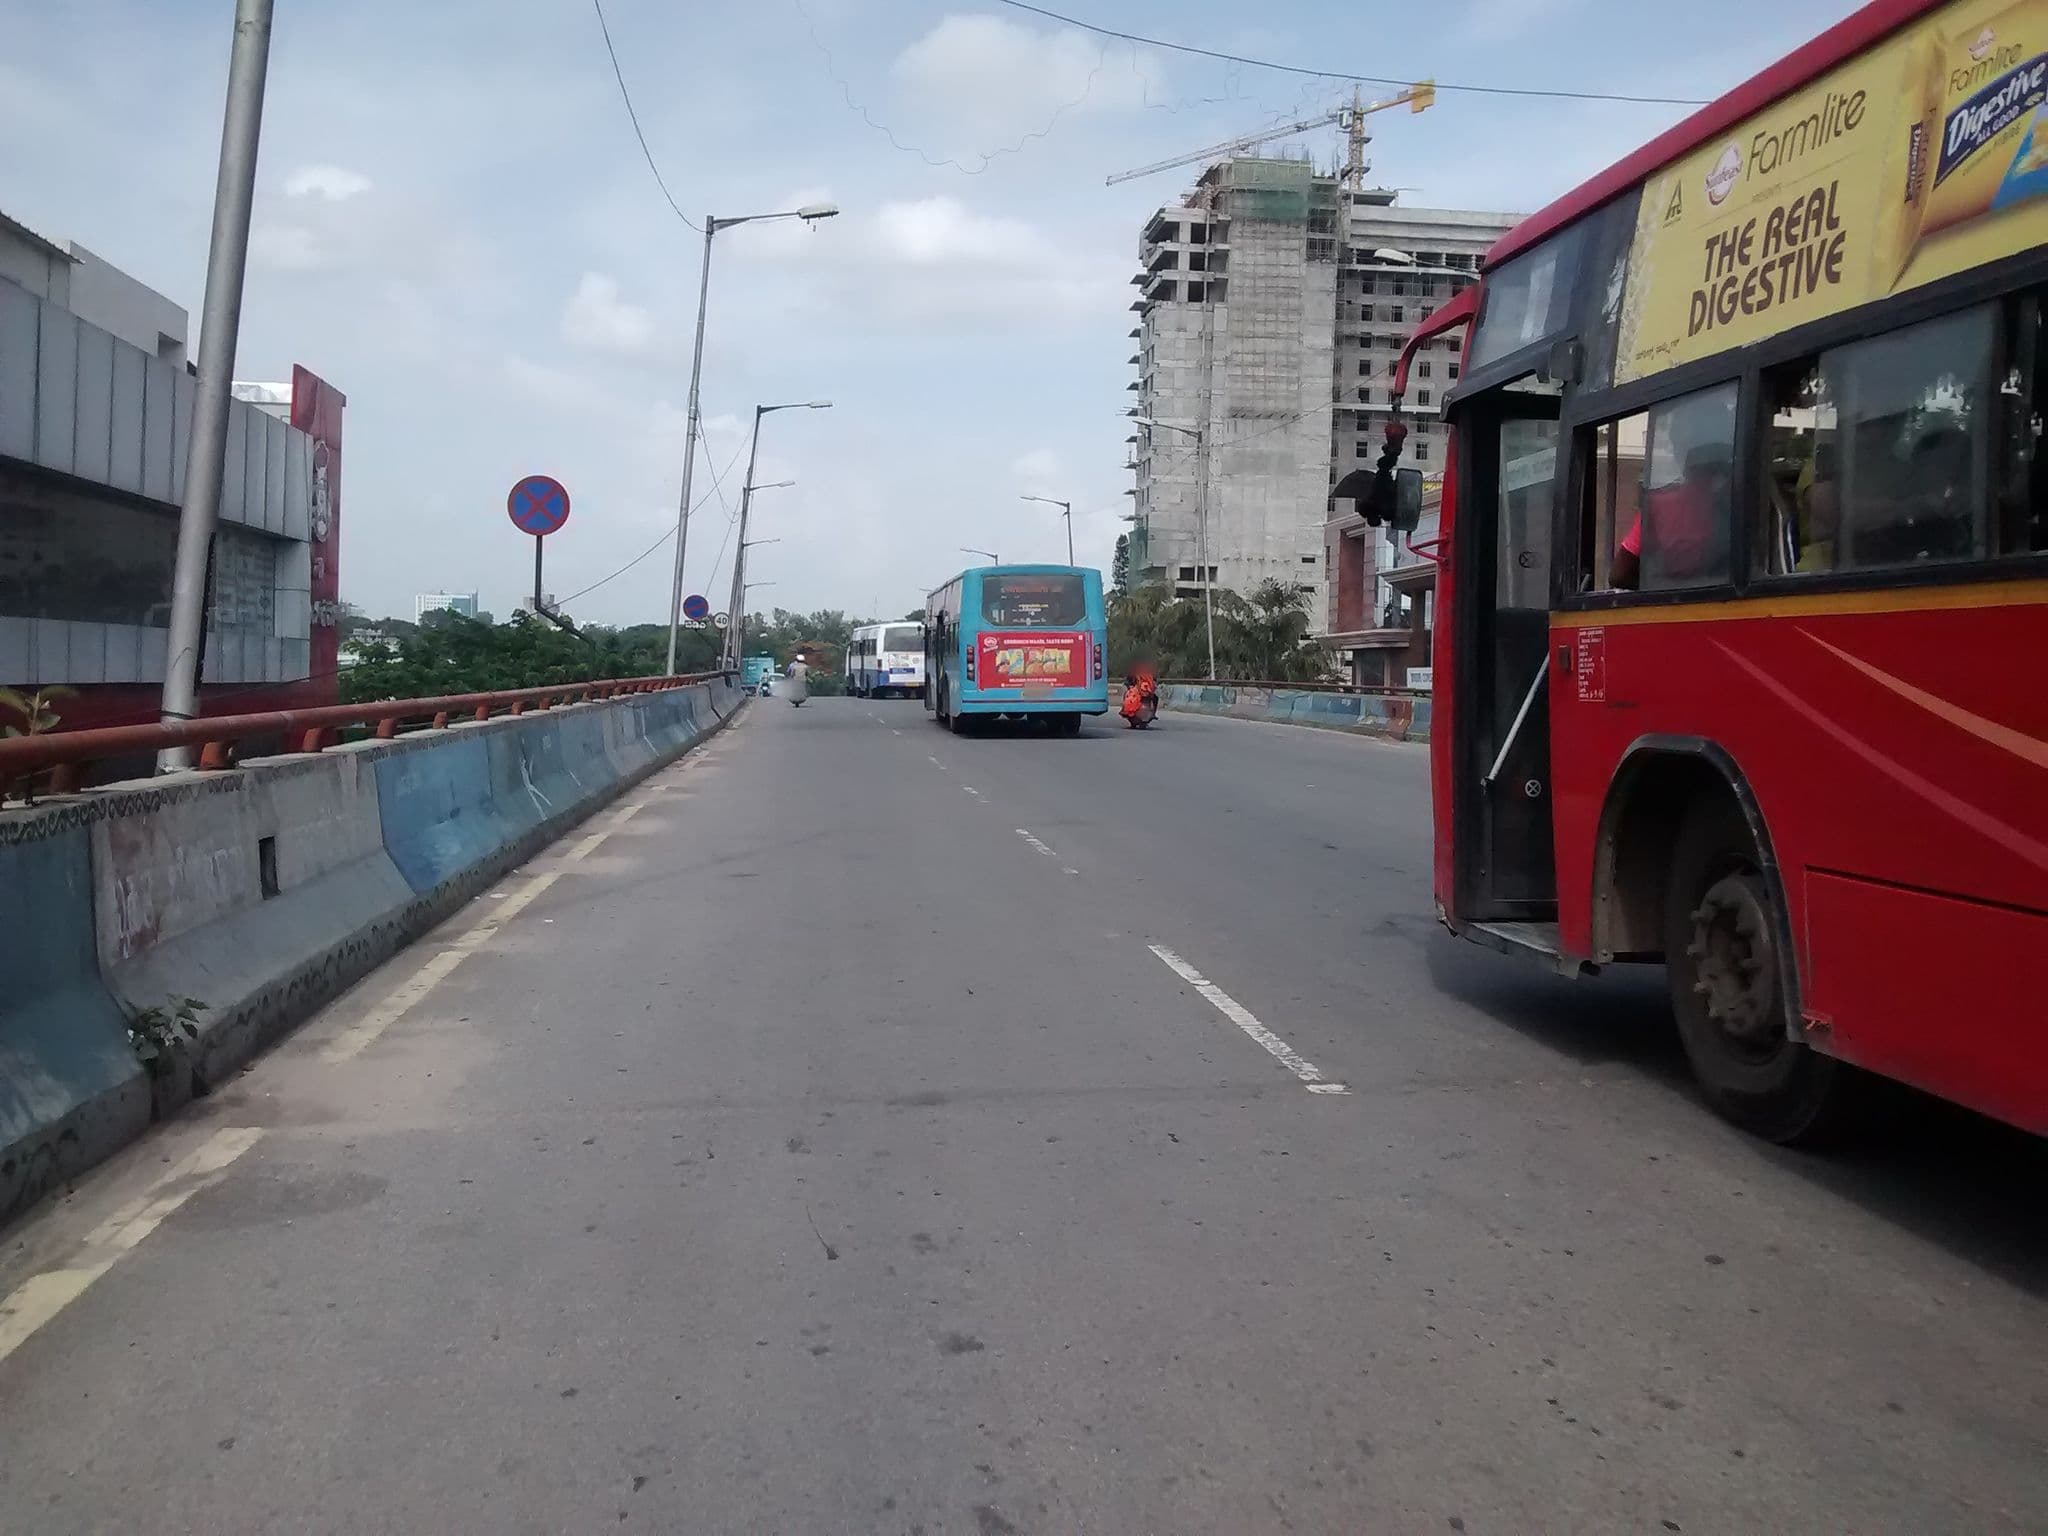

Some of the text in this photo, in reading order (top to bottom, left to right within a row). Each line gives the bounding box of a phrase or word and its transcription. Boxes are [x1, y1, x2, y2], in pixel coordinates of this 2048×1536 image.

[1746, 90, 1866, 181] Farmlite
[1948, 61, 2046, 157] Digestive
[1704, 180, 1840, 283] THE REAL
[1688, 230, 1847, 338] DIGESTIVE
